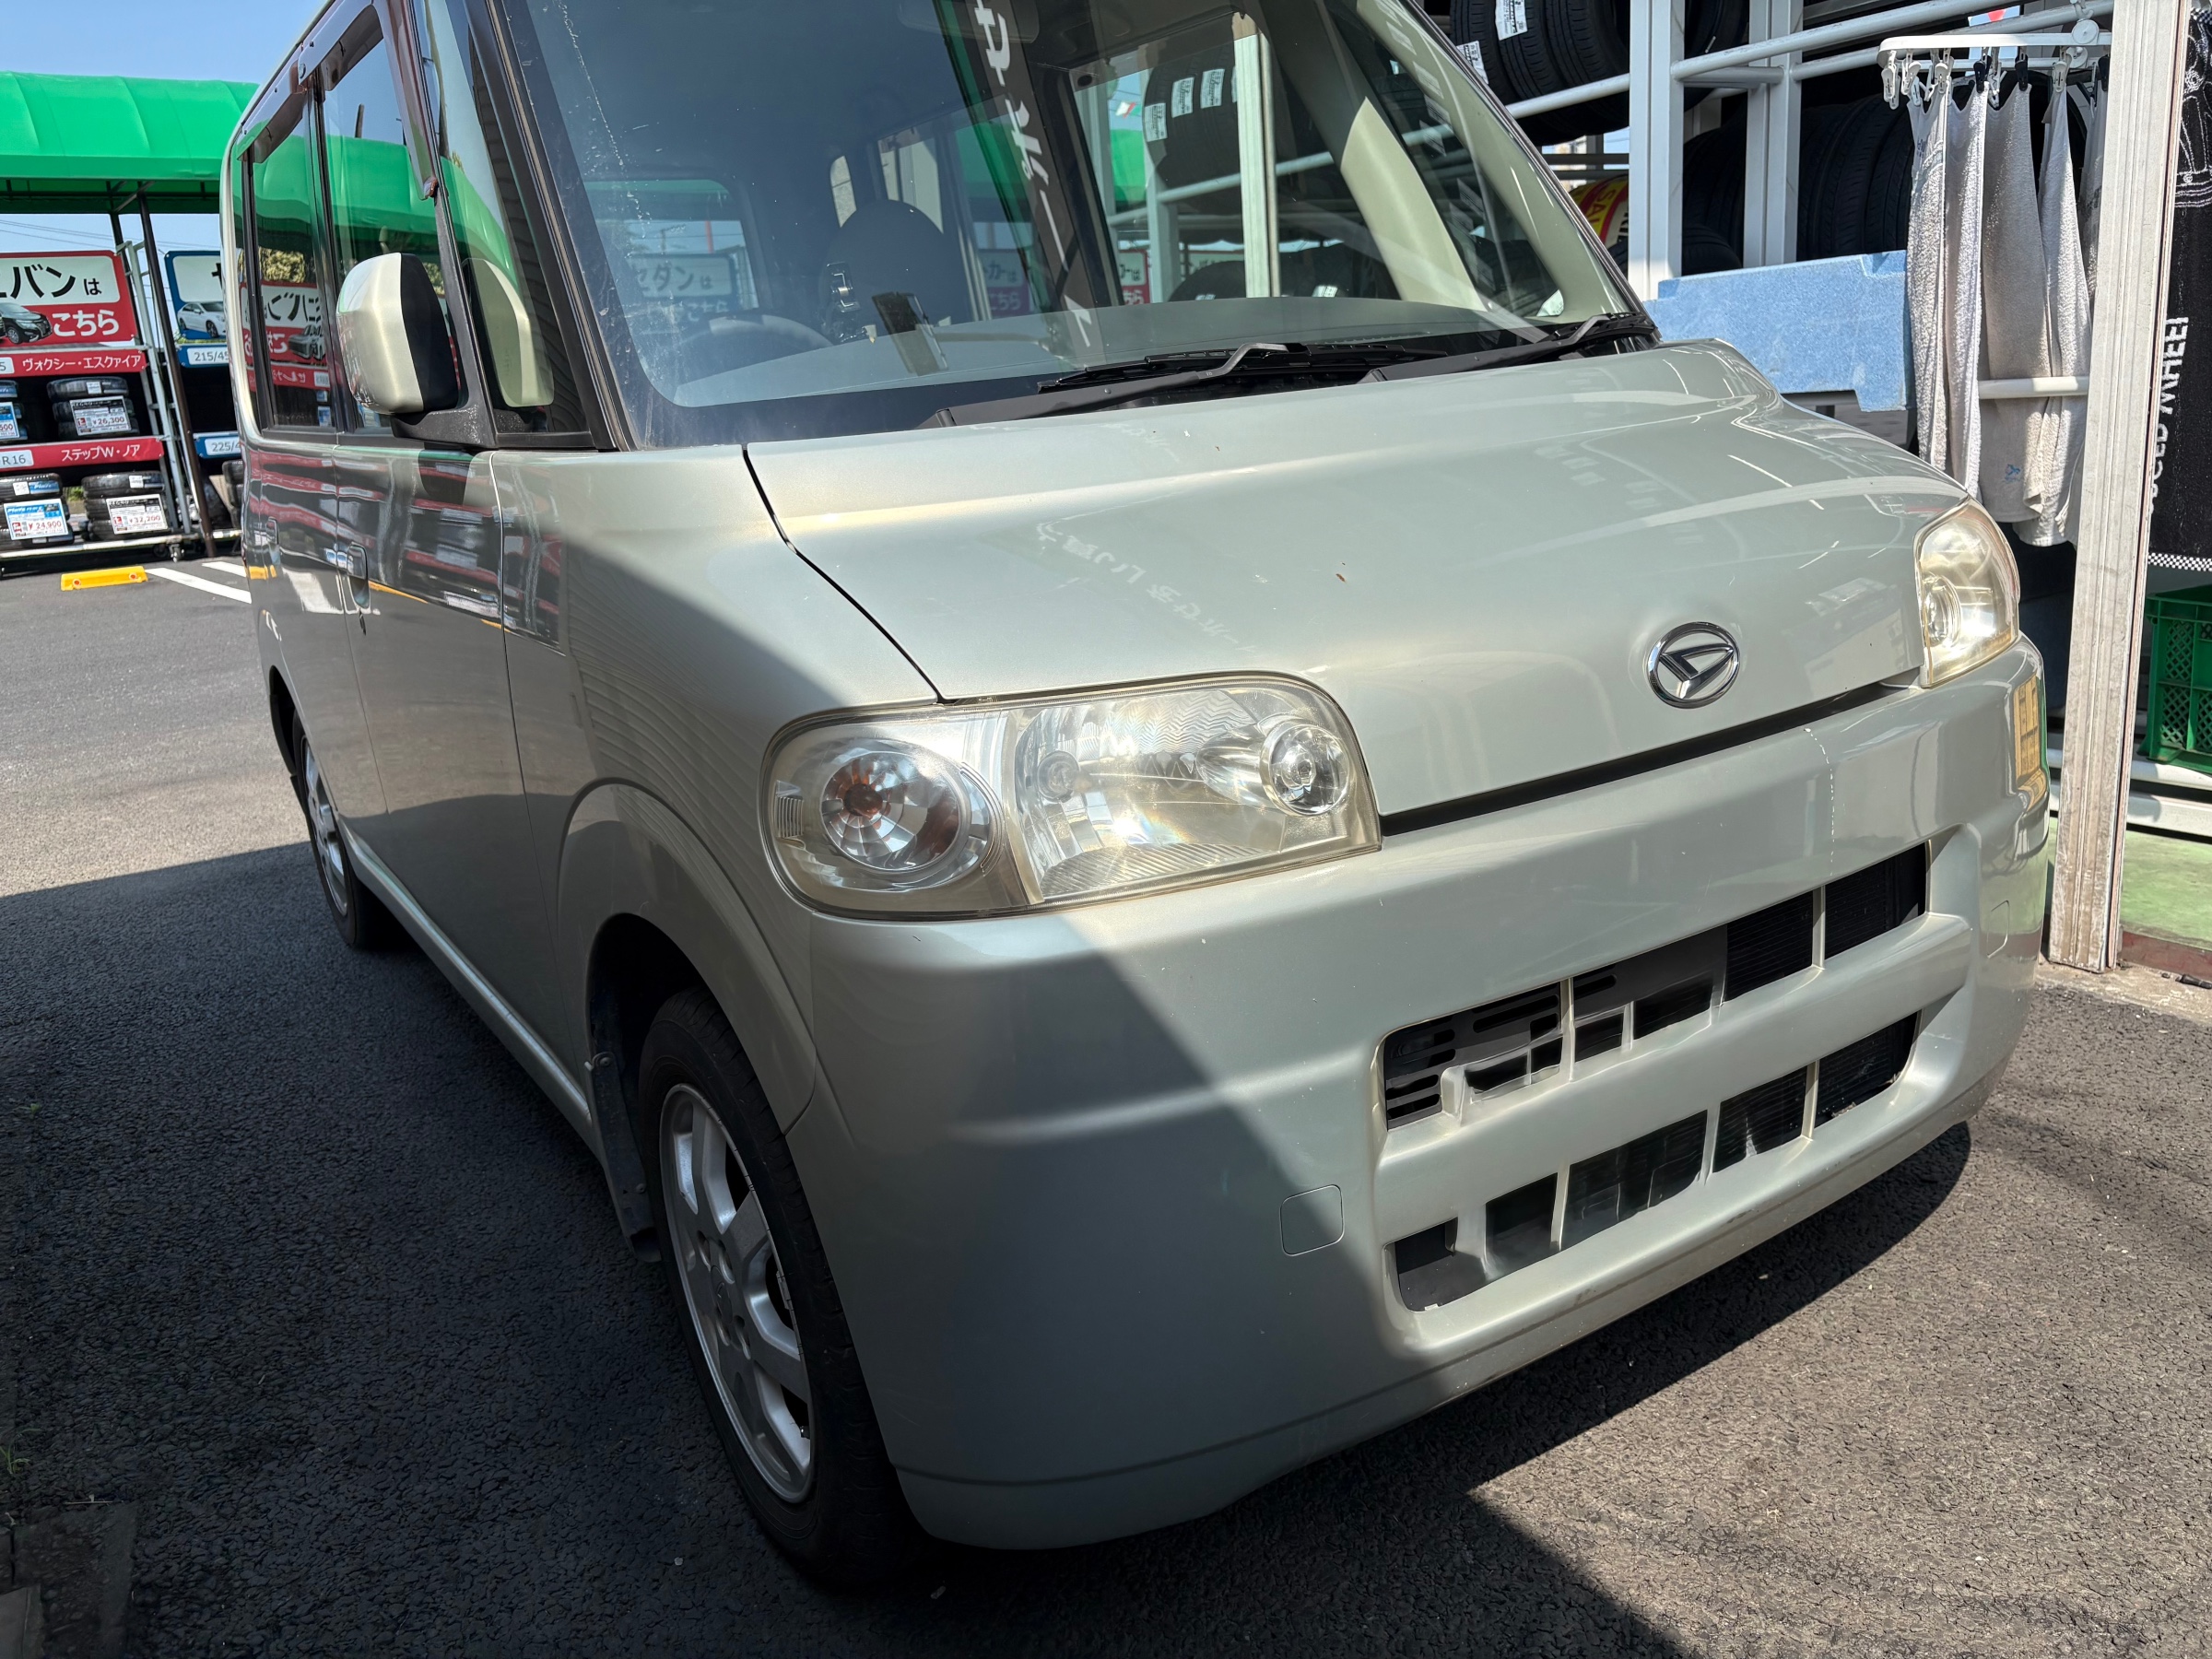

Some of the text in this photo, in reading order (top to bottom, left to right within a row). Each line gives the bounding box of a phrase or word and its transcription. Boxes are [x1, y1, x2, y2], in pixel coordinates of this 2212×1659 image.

[0, 264, 101, 299] バンは
[53, 310, 119, 337] こちら
